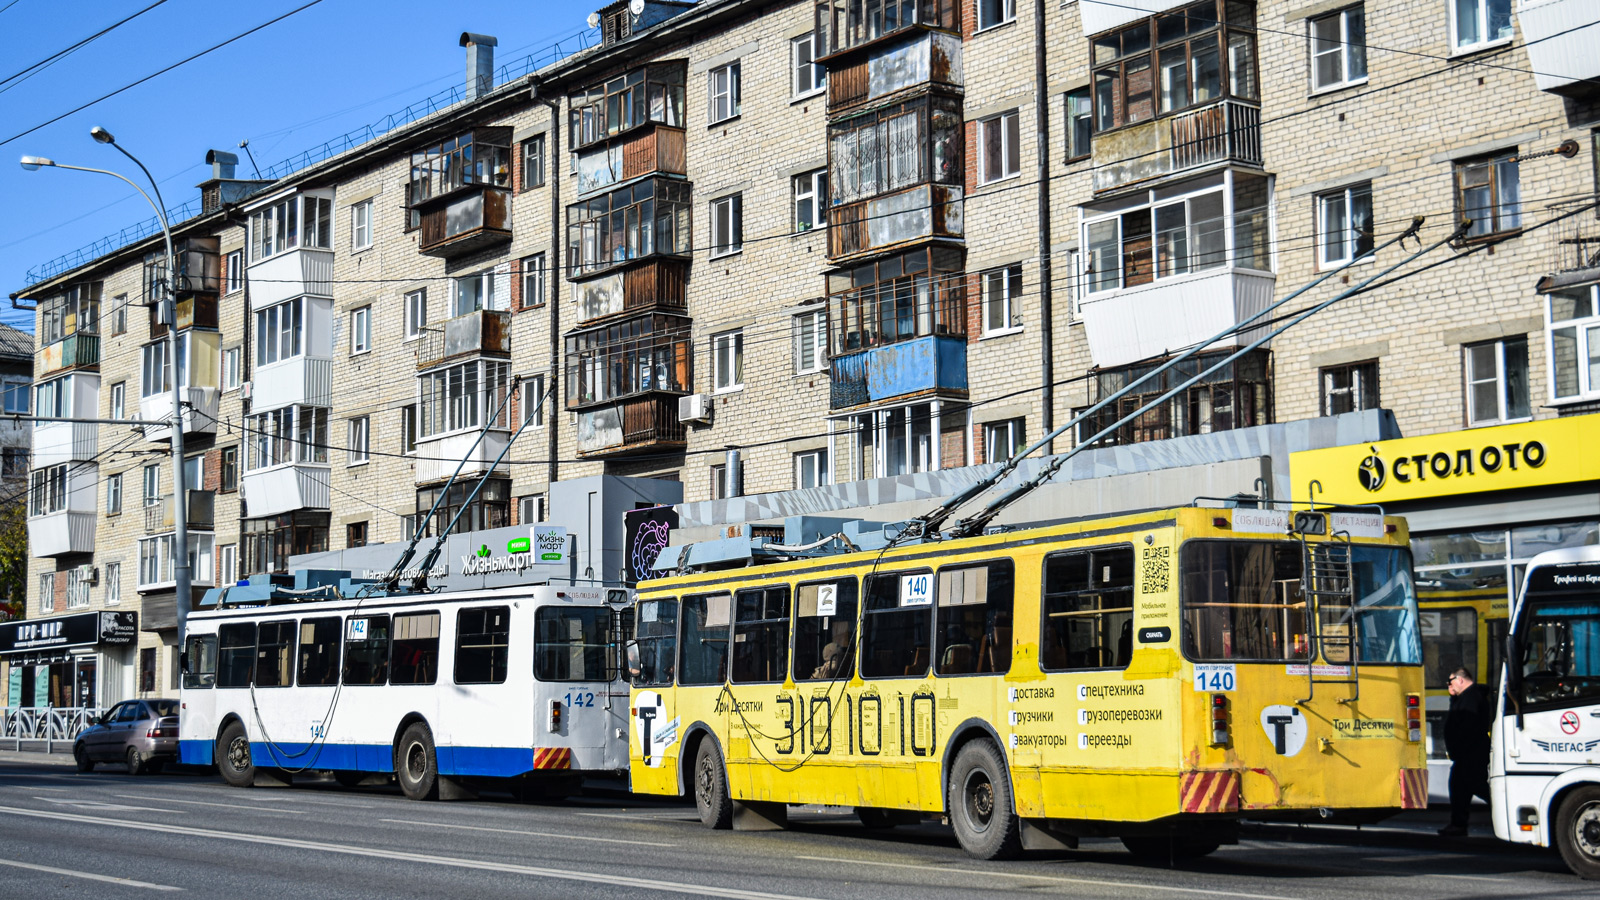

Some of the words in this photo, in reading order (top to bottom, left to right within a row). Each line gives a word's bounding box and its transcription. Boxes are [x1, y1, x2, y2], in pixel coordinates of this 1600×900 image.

[1235, 515, 1283, 527] СОБЛЮДАЙ
[1297, 516, 1322, 531] 27
[1335, 517, 1381, 527] ДИСТАНЦИЮ
[511, 541, 527, 549] мини
[537, 533, 565, 543] Жизнь
[540, 542, 562, 552] март
[461, 552, 532, 575] Жизньмарт
[907, 576, 928, 597] 140
[609, 590, 625, 602] 27
[352, 620, 365, 633] 142
[1197, 672, 1234, 691] 140
[1012, 687, 1055, 702] доставка
[1081, 684, 1144, 699] спецтехника
[564, 692, 595, 708] 142
[730, 698, 763, 716] Десятки
[1012, 711, 1054, 725] грузчики
[1082, 709, 1163, 725] грузоперевозки
[310, 725, 325, 738] 142
[1332, 718, 1351, 731] Три
[1352, 718, 1394, 732] Десятки
[1013, 734, 1067, 748] эвакуаторы
[1083, 734, 1132, 748] переезды
[1551, 742, 1584, 752] ПЕГАС
